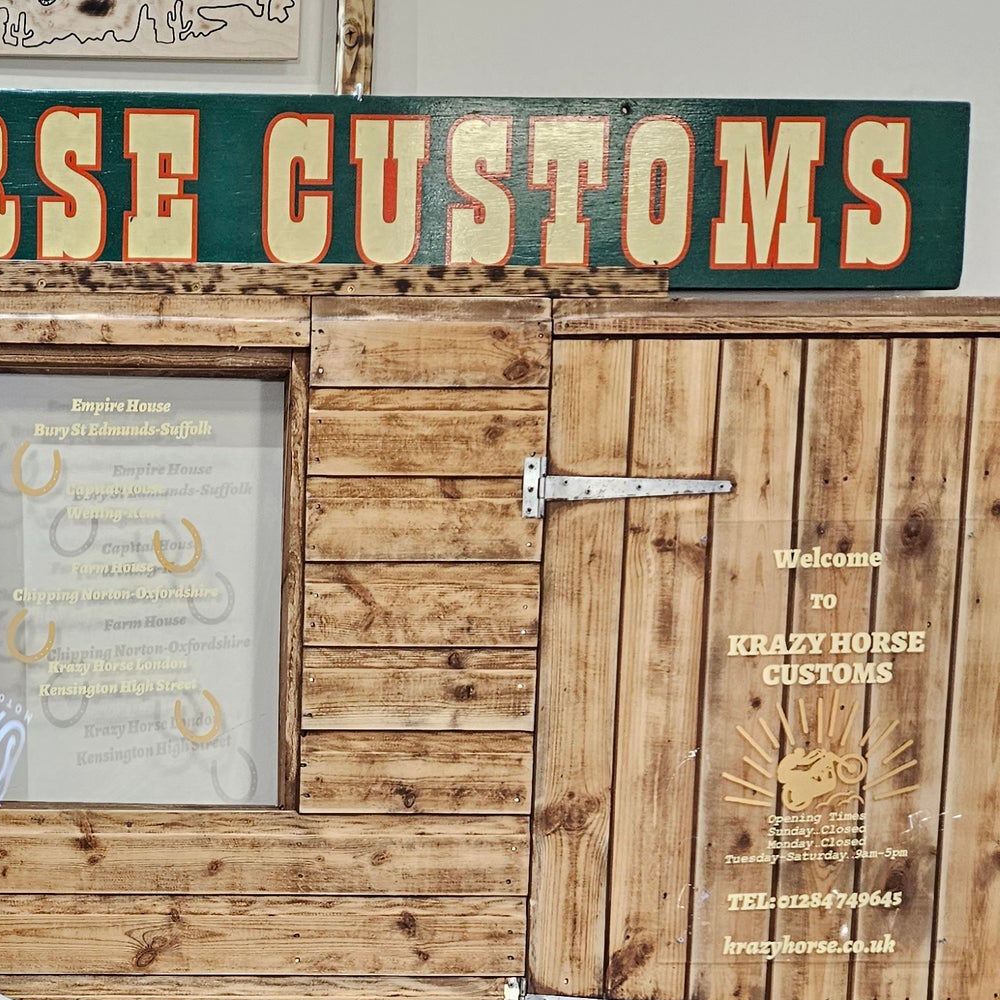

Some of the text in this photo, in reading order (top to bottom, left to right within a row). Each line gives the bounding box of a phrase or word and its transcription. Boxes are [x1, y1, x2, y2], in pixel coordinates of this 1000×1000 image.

[262, 113, 911, 270] CUSTOMS
[71, 398, 171, 415] Empire House
[34, 421, 212, 440] Bury St Edmunds-Suffolk
[773, 546, 882, 569] Welcome
[810, 593, 837, 610] TO
[727, 631, 926, 656] KRAZY HORSE
[48, 659, 187, 677] Krazy Horse London
[762, 662, 893, 686] CUSTOMS
[39, 679, 197, 697] Kensington High Street
[767, 812, 867, 827] Opening Times
[723, 934, 896, 960] krazyhorse.co.uk
